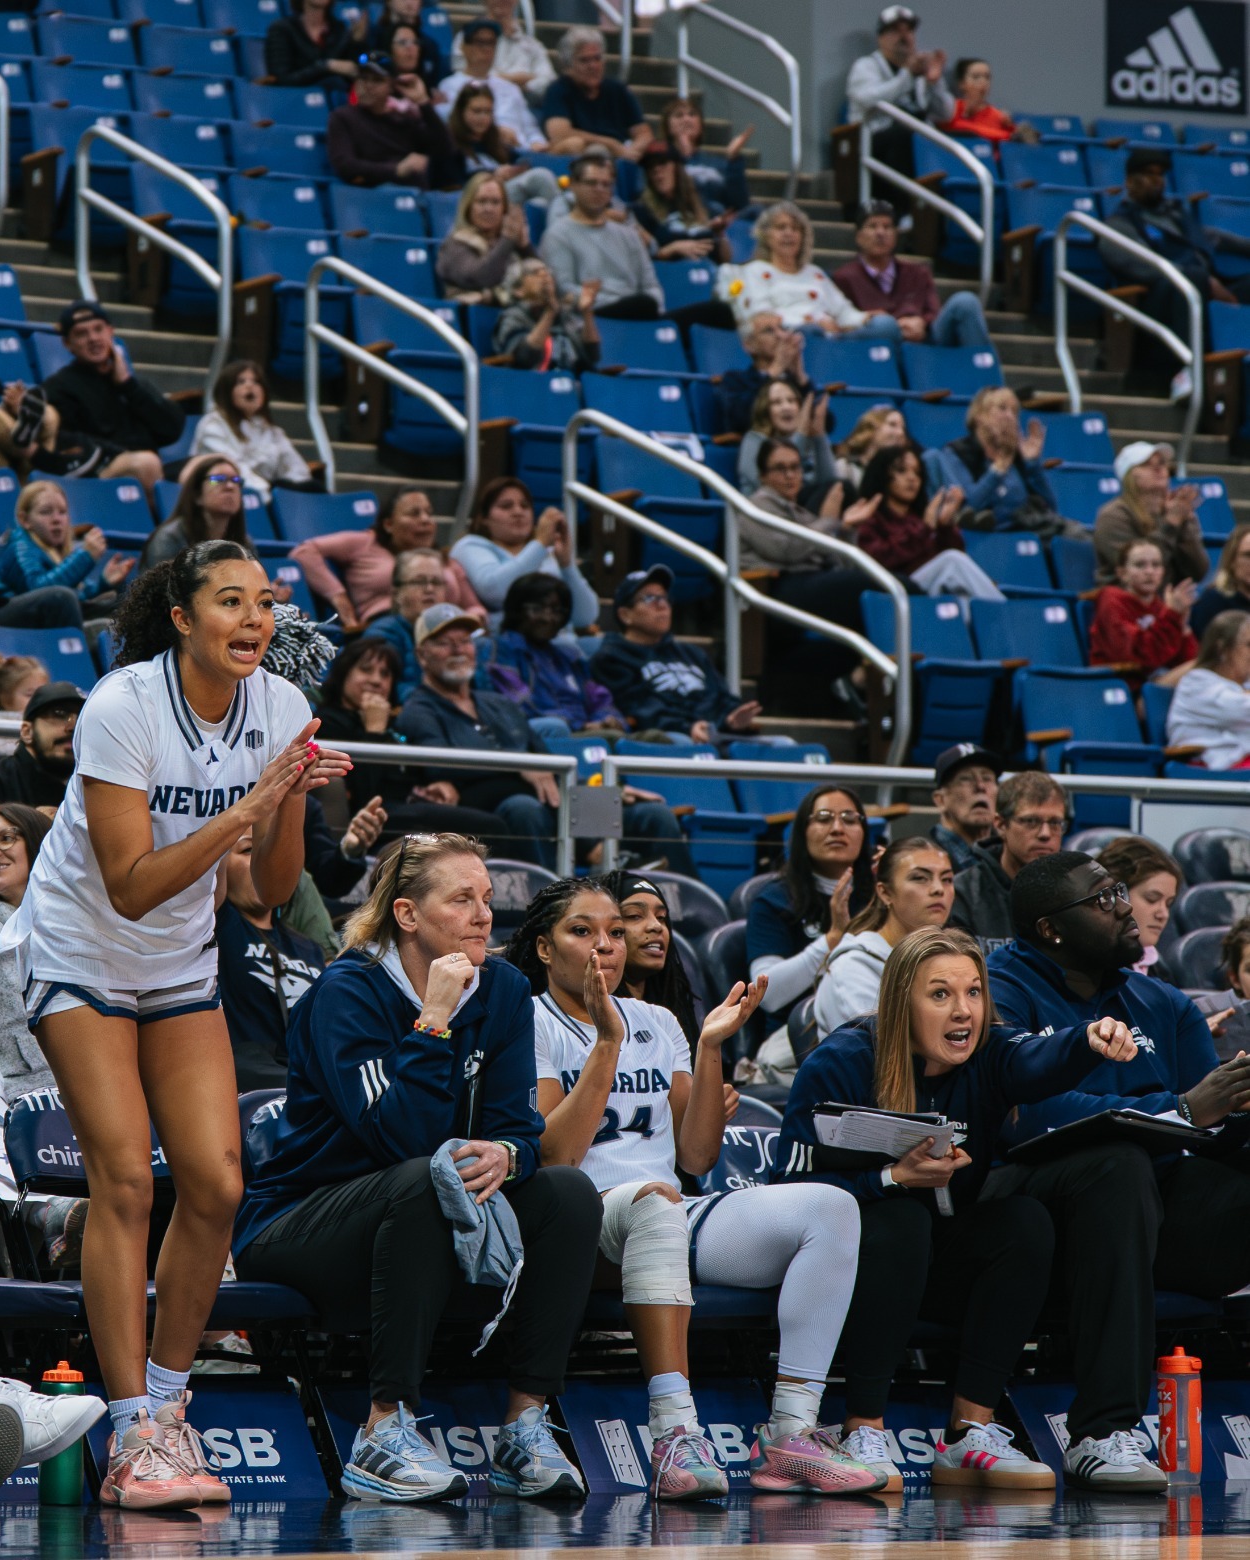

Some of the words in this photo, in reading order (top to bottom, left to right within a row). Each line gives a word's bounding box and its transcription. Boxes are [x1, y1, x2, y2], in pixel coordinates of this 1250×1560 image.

[1111, 66, 1241, 107] adidas
[561, 1068, 671, 1094] NADA
[590, 1103, 656, 1149] 24
[202, 1428, 281, 1468] SB
[16, 1477, 40, 1486] BAN
[221, 1475, 254, 1485] STATE
[256, 1474, 287, 1484] BANK
[466, 1473, 490, 1482] STAT
[730, 1470, 751, 1479] BAN
